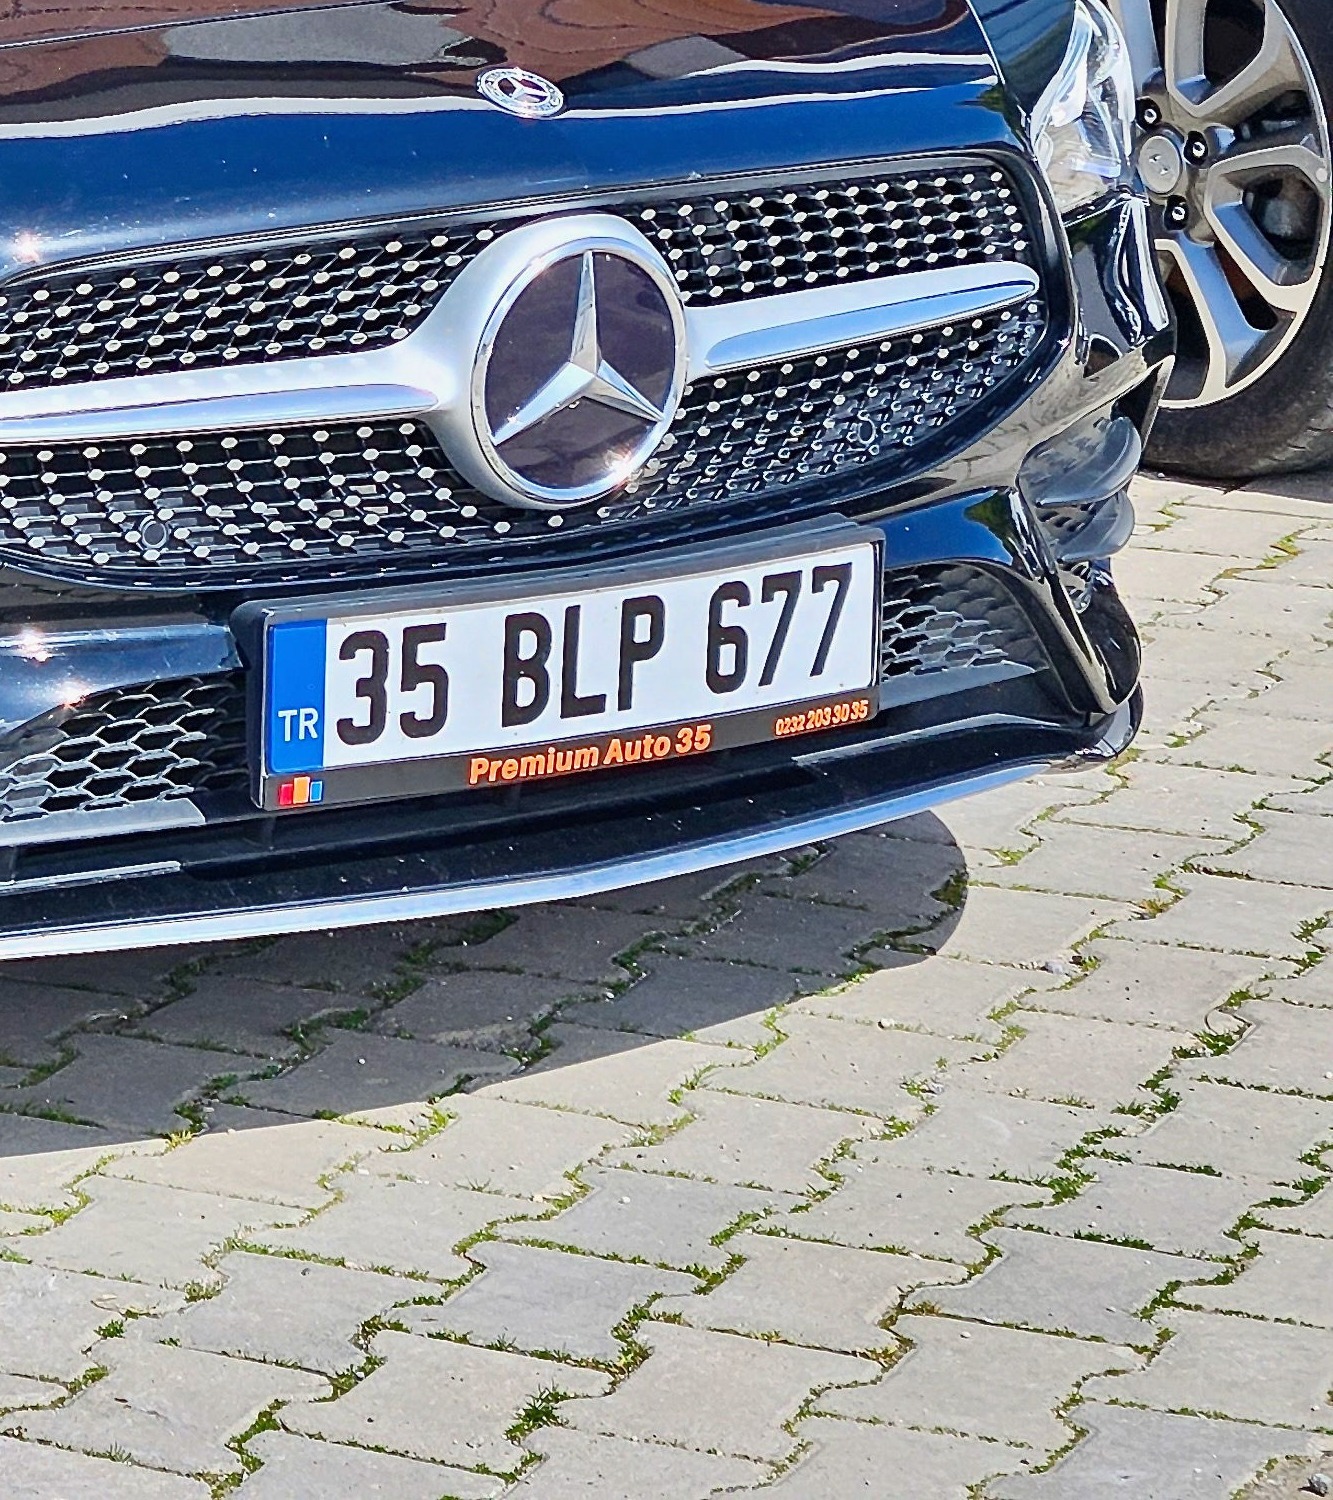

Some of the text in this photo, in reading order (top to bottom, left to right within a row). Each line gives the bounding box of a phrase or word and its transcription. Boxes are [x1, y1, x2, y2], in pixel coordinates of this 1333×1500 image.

[336, 561, 853, 746] 35 BLP 677
[277, 707, 319, 742] TR
[469, 724, 712, 785] Premium Auto 35
